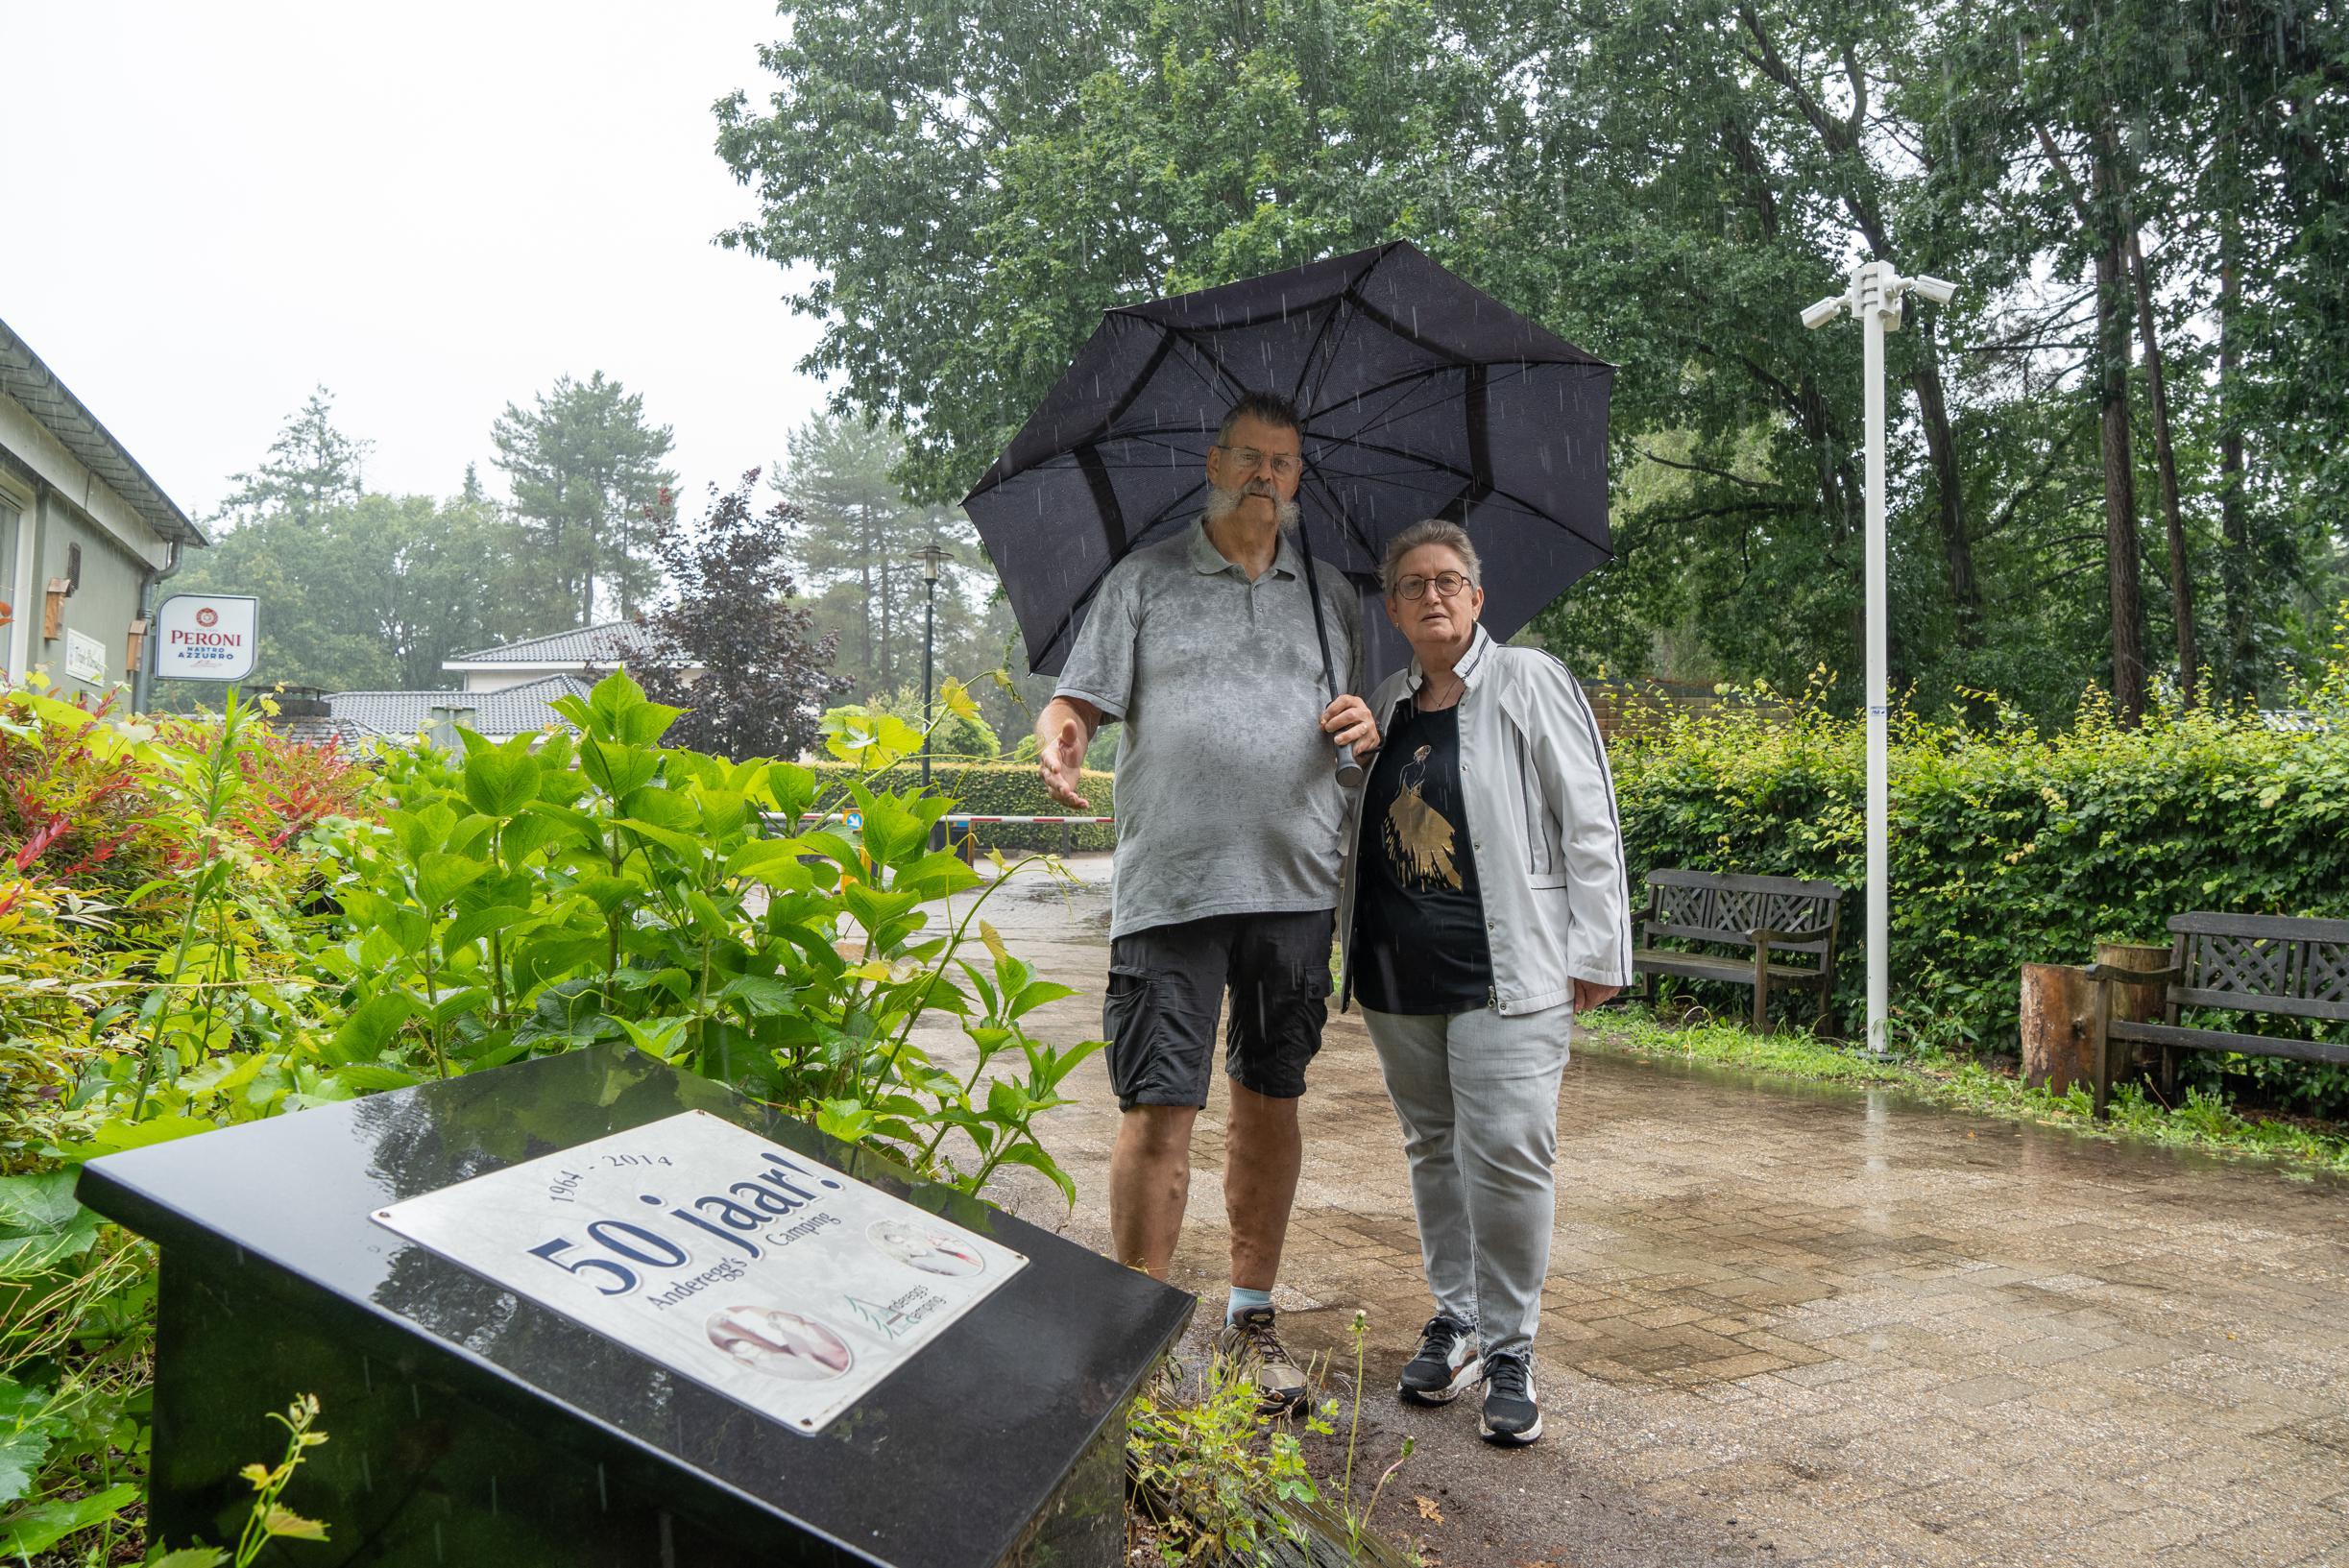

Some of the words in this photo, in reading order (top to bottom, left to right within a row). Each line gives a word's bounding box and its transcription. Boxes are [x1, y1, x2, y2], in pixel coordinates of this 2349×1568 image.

[171, 629, 241, 646] PERONI
[548, 1170, 584, 1203] 1964
[601, 1154, 673, 1168] 2014
[528, 1219, 687, 1296] 50
[640, 1151, 841, 1259] jaar!
[645, 1256, 747, 1312] Anderegg's
[765, 1211, 841, 1247] Camping
